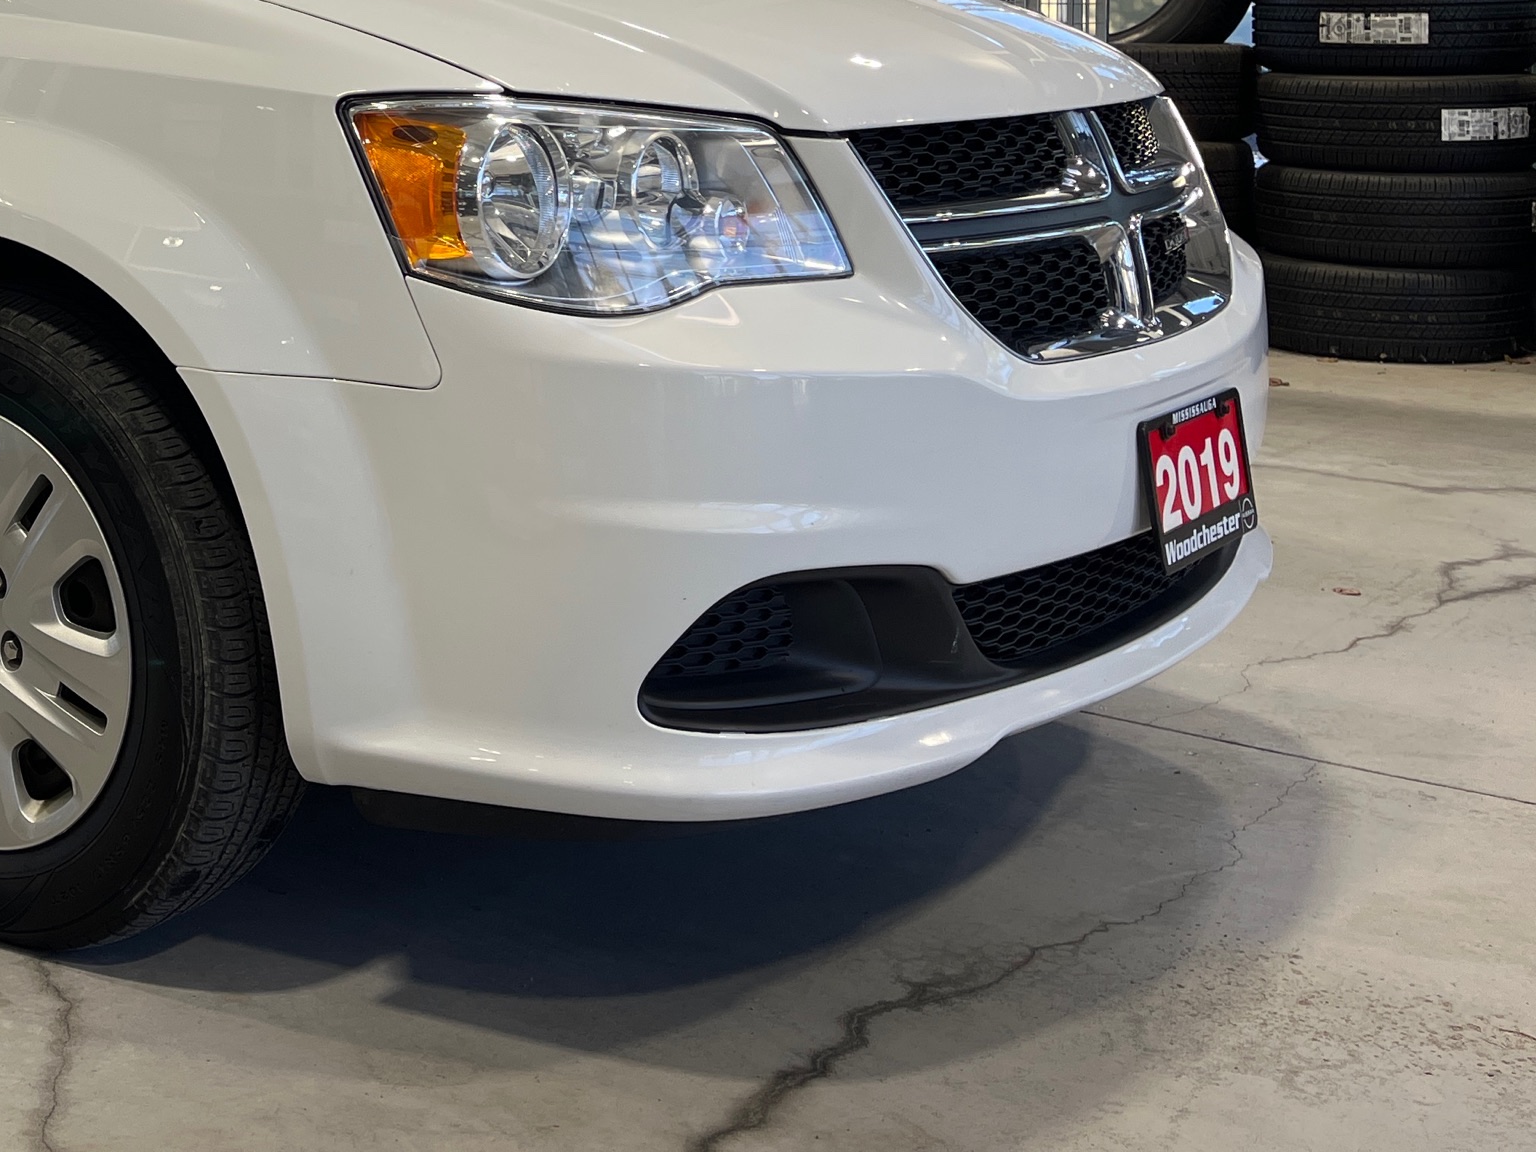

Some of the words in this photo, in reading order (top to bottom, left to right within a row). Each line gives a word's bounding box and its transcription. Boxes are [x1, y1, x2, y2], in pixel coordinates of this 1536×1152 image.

[1172, 397, 1217, 425] MISSISSAUGA
[1155, 427, 1241, 534] 2019
[1165, 512, 1241, 566] Woodchester
